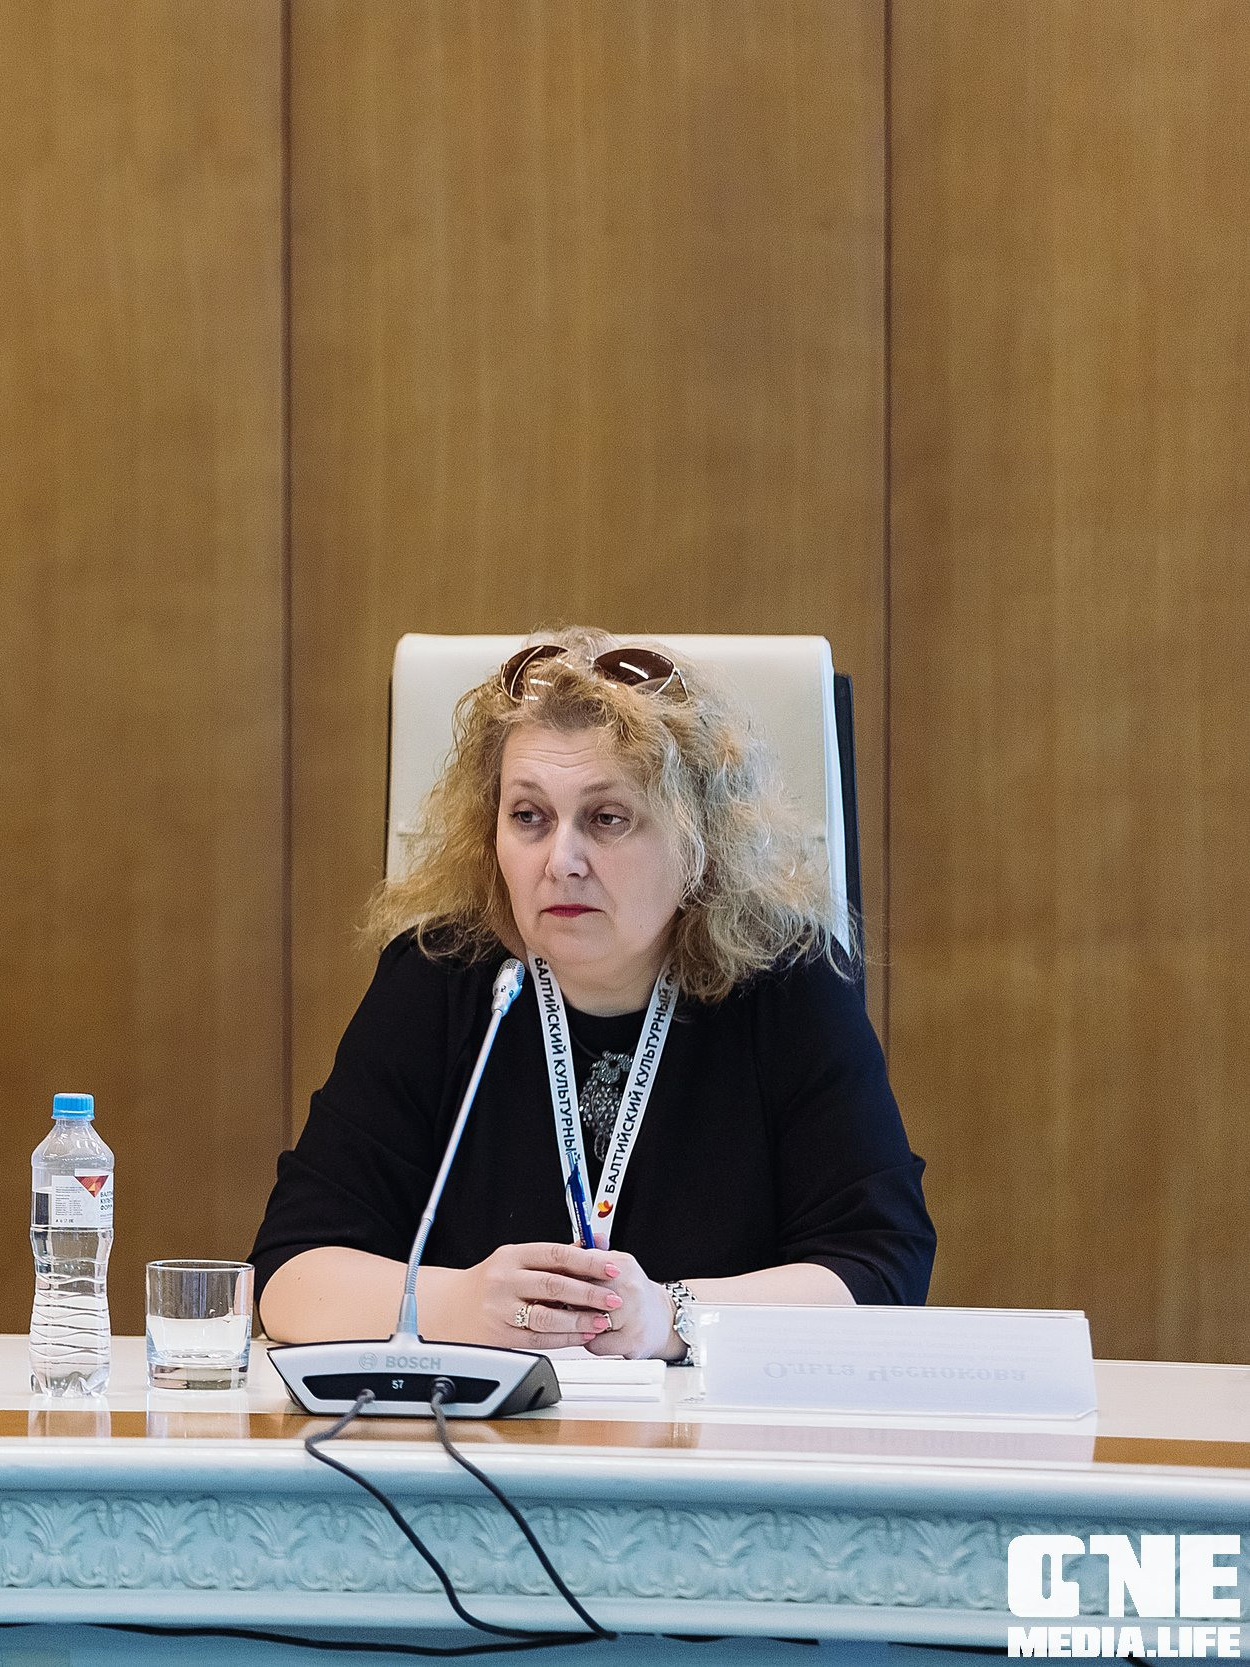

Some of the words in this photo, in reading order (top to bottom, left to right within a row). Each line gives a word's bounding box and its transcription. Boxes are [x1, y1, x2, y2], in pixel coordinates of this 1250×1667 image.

[534, 957, 567, 1055] БАЛТИЙСКИЙ
[604, 1090, 644, 1194] БАЛТИЙСКИЙ
[385, 1355, 441, 1370] BOSCH
[391, 1379, 405, 1390] 57
